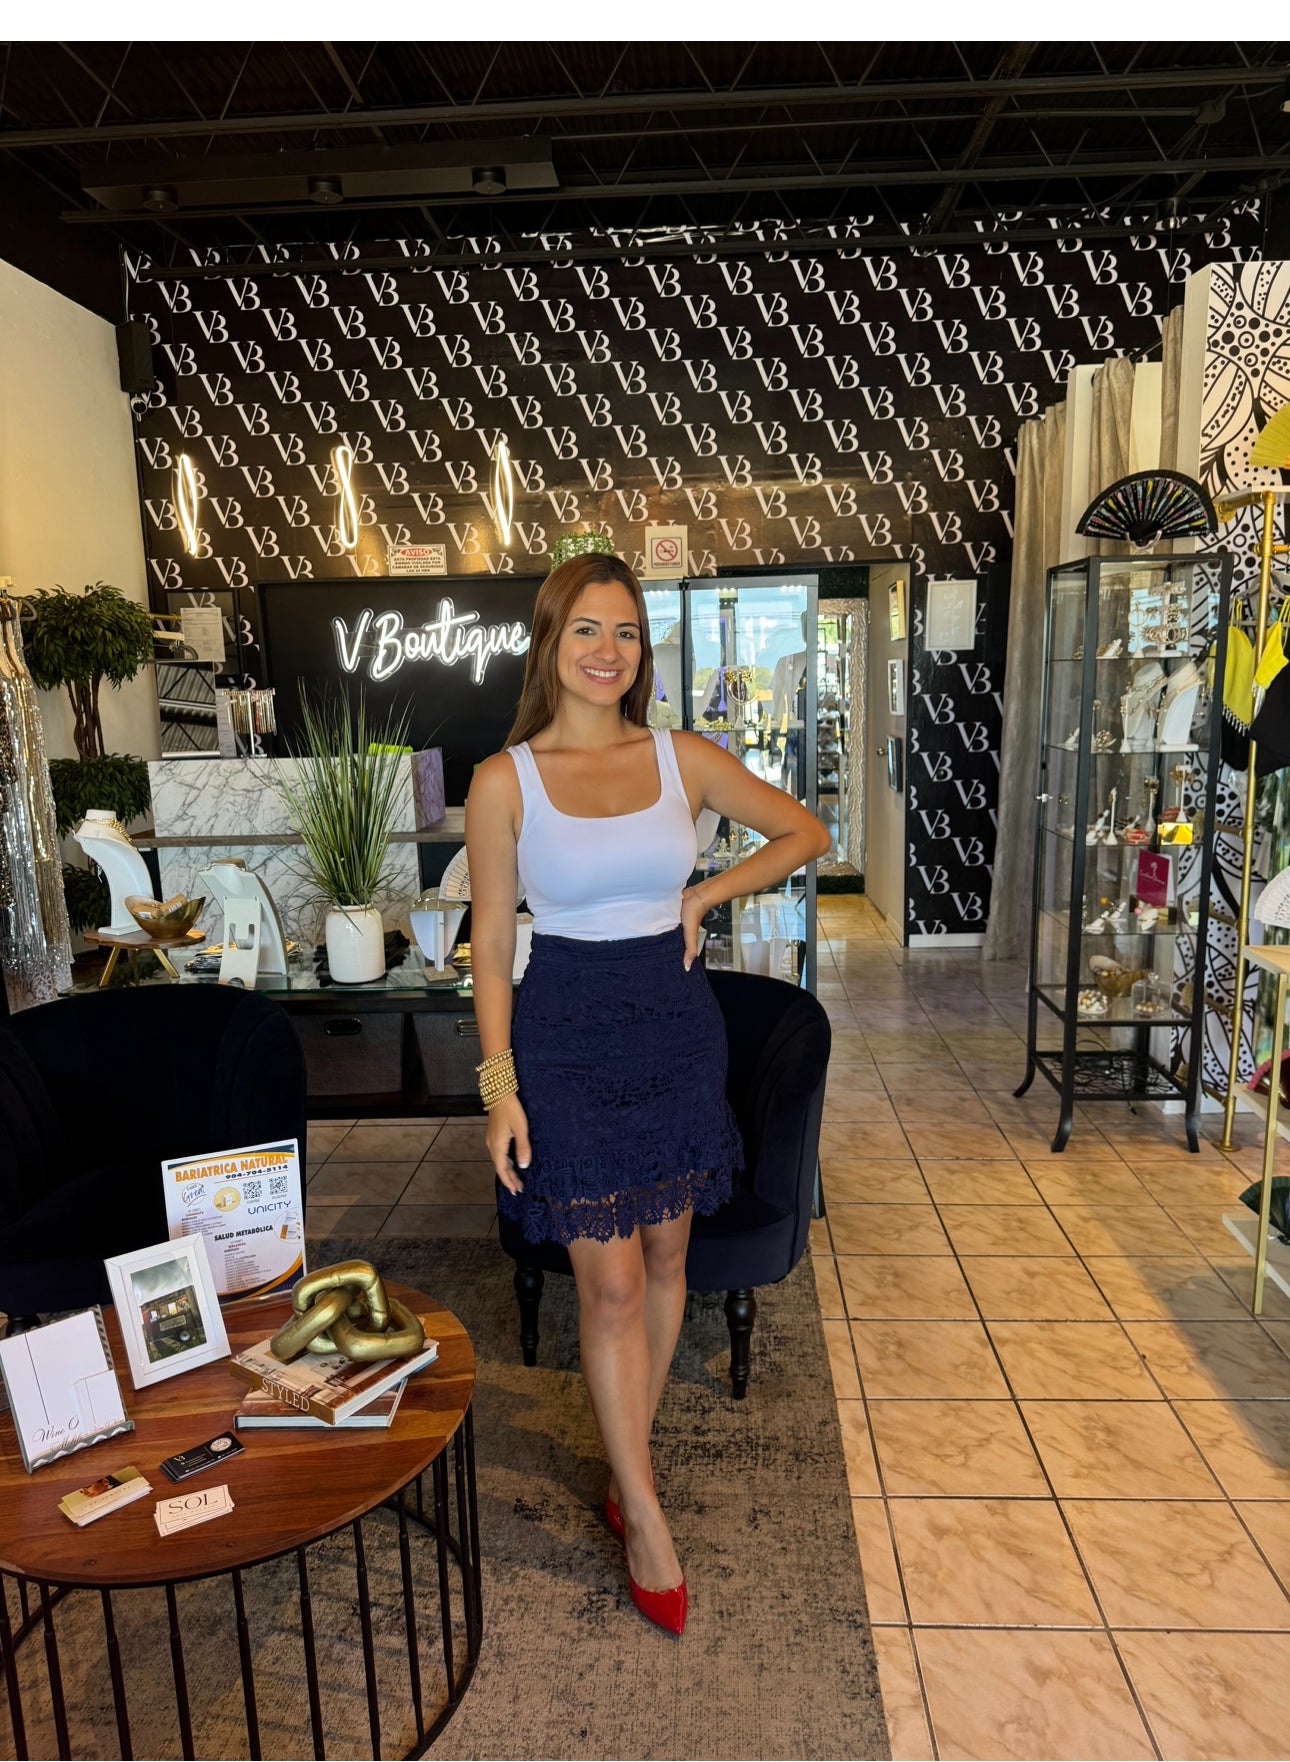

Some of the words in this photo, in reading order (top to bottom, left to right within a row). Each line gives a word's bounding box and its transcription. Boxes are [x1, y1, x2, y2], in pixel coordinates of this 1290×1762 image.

[646, 264, 681, 297] VB
[718, 262, 753, 295] VB
[790, 259, 825, 293] VB
[862, 256, 897, 290] VB
[935, 254, 970, 288] VB
[1009, 252, 1044, 286] VB
[1082, 250, 1117, 284] VB
[1157, 248, 1192, 283] VB
[157, 281, 191, 313] VB
[225, 278, 260, 310] VB
[294, 275, 329, 308] VB
[364, 273, 399, 306] VB
[434, 271, 469, 304] VB
[504, 268, 539, 301] VB
[574, 267, 610, 299] VB
[539, 299, 575, 332] VB
[610, 297, 646, 330] VB
[682, 295, 717, 328] VB
[753, 293, 788, 326] VB
[825, 291, 860, 324] VB
[898, 288, 933, 322] VB
[971, 286, 1006, 320] VB
[1044, 284, 1079, 318] VB
[1118, 283, 1153, 316] VB
[193, 311, 228, 343] VB
[261, 308, 297, 340] VB
[330, 306, 366, 339] VB
[400, 304, 435, 337] VB
[470, 302, 505, 334] VB
[1079, 316, 1114, 350] VB
[506, 332, 541, 365] VB
[576, 330, 611, 363] VB
[646, 328, 681, 361] VB
[717, 326, 753, 360] VB
[789, 324, 824, 358] VB
[861, 322, 896, 355] VB
[933, 320, 968, 353] VB
[1006, 318, 1041, 351] VB
[162, 344, 197, 375] VB
[229, 341, 265, 373] VB
[298, 339, 333, 371] VB
[367, 337, 402, 369] VB
[437, 335, 472, 367] VB
[403, 367, 439, 400] VB
[472, 365, 507, 398] VB
[541, 363, 576, 396] VB
[611, 361, 646, 394] VB
[682, 360, 717, 392] VB
[753, 358, 788, 391] VB
[825, 355, 859, 389] VB
[896, 353, 931, 386] VB
[969, 351, 1004, 384] VB
[198, 374, 233, 405] VB
[266, 371, 301, 403] VB
[334, 369, 369, 401] VB
[931, 384, 966, 417] VB
[1004, 383, 1038, 416] VB
[303, 402, 337, 433] VB
[371, 400, 405, 432] VB
[440, 398, 474, 430] VB
[509, 396, 543, 428] VB
[577, 394, 612, 426] VB
[647, 392, 682, 425] VB
[718, 391, 752, 423] VB
[788, 389, 823, 422] VB
[860, 387, 894, 419] VB
[168, 406, 202, 437] VB
[235, 404, 269, 435] VB
[895, 417, 929, 450] VB
[967, 415, 1001, 448] VB
[204, 436, 238, 467] VB
[271, 434, 305, 465] VB
[407, 430, 442, 462] VB
[544, 426, 578, 459] VB
[613, 425, 647, 458] VB
[683, 423, 717, 456] VB
[753, 422, 787, 454] VB
[824, 420, 858, 452] VB
[139, 438, 172, 469] VB
[859, 451, 893, 484] VB
[930, 449, 964, 481] VB
[240, 466, 274, 497] VB
[375, 463, 409, 494] VB
[445, 461, 477, 493] VB
[513, 460, 545, 493] VB
[579, 458, 613, 491] VB
[648, 457, 682, 490] VB
[719, 455, 752, 488] VB
[788, 453, 823, 487] VB
[276, 496, 310, 527] VB
[411, 493, 445, 524] VB
[546, 490, 580, 523] VB
[615, 490, 648, 521] VB
[684, 487, 717, 520] VB
[753, 486, 787, 518] VB
[822, 483, 857, 516] VB
[893, 482, 928, 516] VB
[965, 480, 999, 512] VB
[145, 499, 178, 531] VB
[209, 497, 243, 528] VB
[928, 512, 962, 544] VB
[244, 527, 279, 557] VB
[448, 523, 481, 555] VB
[512, 522, 547, 554] VB
[718, 518, 752, 550] VB
[787, 516, 821, 548] VB
[857, 514, 891, 546] VB
[151, 559, 182, 589] VB
[214, 557, 248, 587] VB
[333, 608, 373, 673] V
[370, 597, 530, 686] Boutique
[958, 663, 991, 694] VB
[921, 694, 954, 724] VB
[956, 722, 988, 752] VB
[920, 752, 952, 781] VB
[954, 780, 986, 809] VB
[919, 810, 950, 839] VB
[952, 837, 984, 866] VB
[917, 866, 949, 894] VB
[951, 893, 982, 920] VB
[175, 1161, 237, 1182] BARIATRICA
[241, 1155, 288, 1172] NATURAL
[226, 1164, 288, 1180] 904-704-5114
[248, 1200, 292, 1215] UNICITY
[214, 1232, 234, 1242] SALUD
[262, 1378, 310, 1412] STYLED
[32, 1425, 64, 1443] Wine
[168, 1493, 218, 1515] SOL
